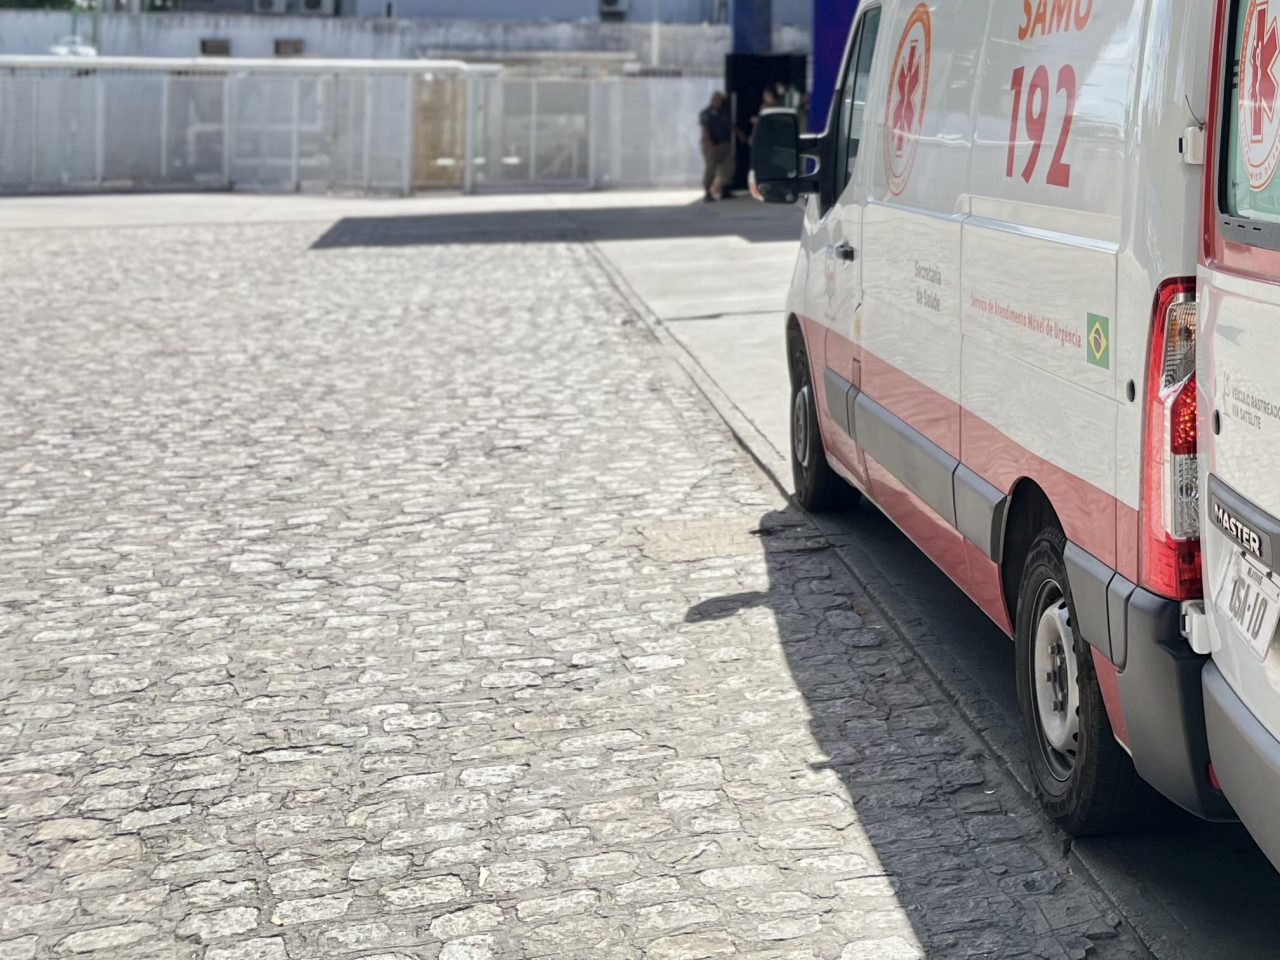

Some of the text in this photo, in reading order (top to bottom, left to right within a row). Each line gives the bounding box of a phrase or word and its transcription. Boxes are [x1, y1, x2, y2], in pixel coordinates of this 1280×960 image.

[1004, 63, 1077, 188] 192
[914, 260, 942, 286] Secretaria
[988, 298, 994, 315] de
[1045, 319, 1053, 336] de
[1214, 503, 1262, 558] MASTER
